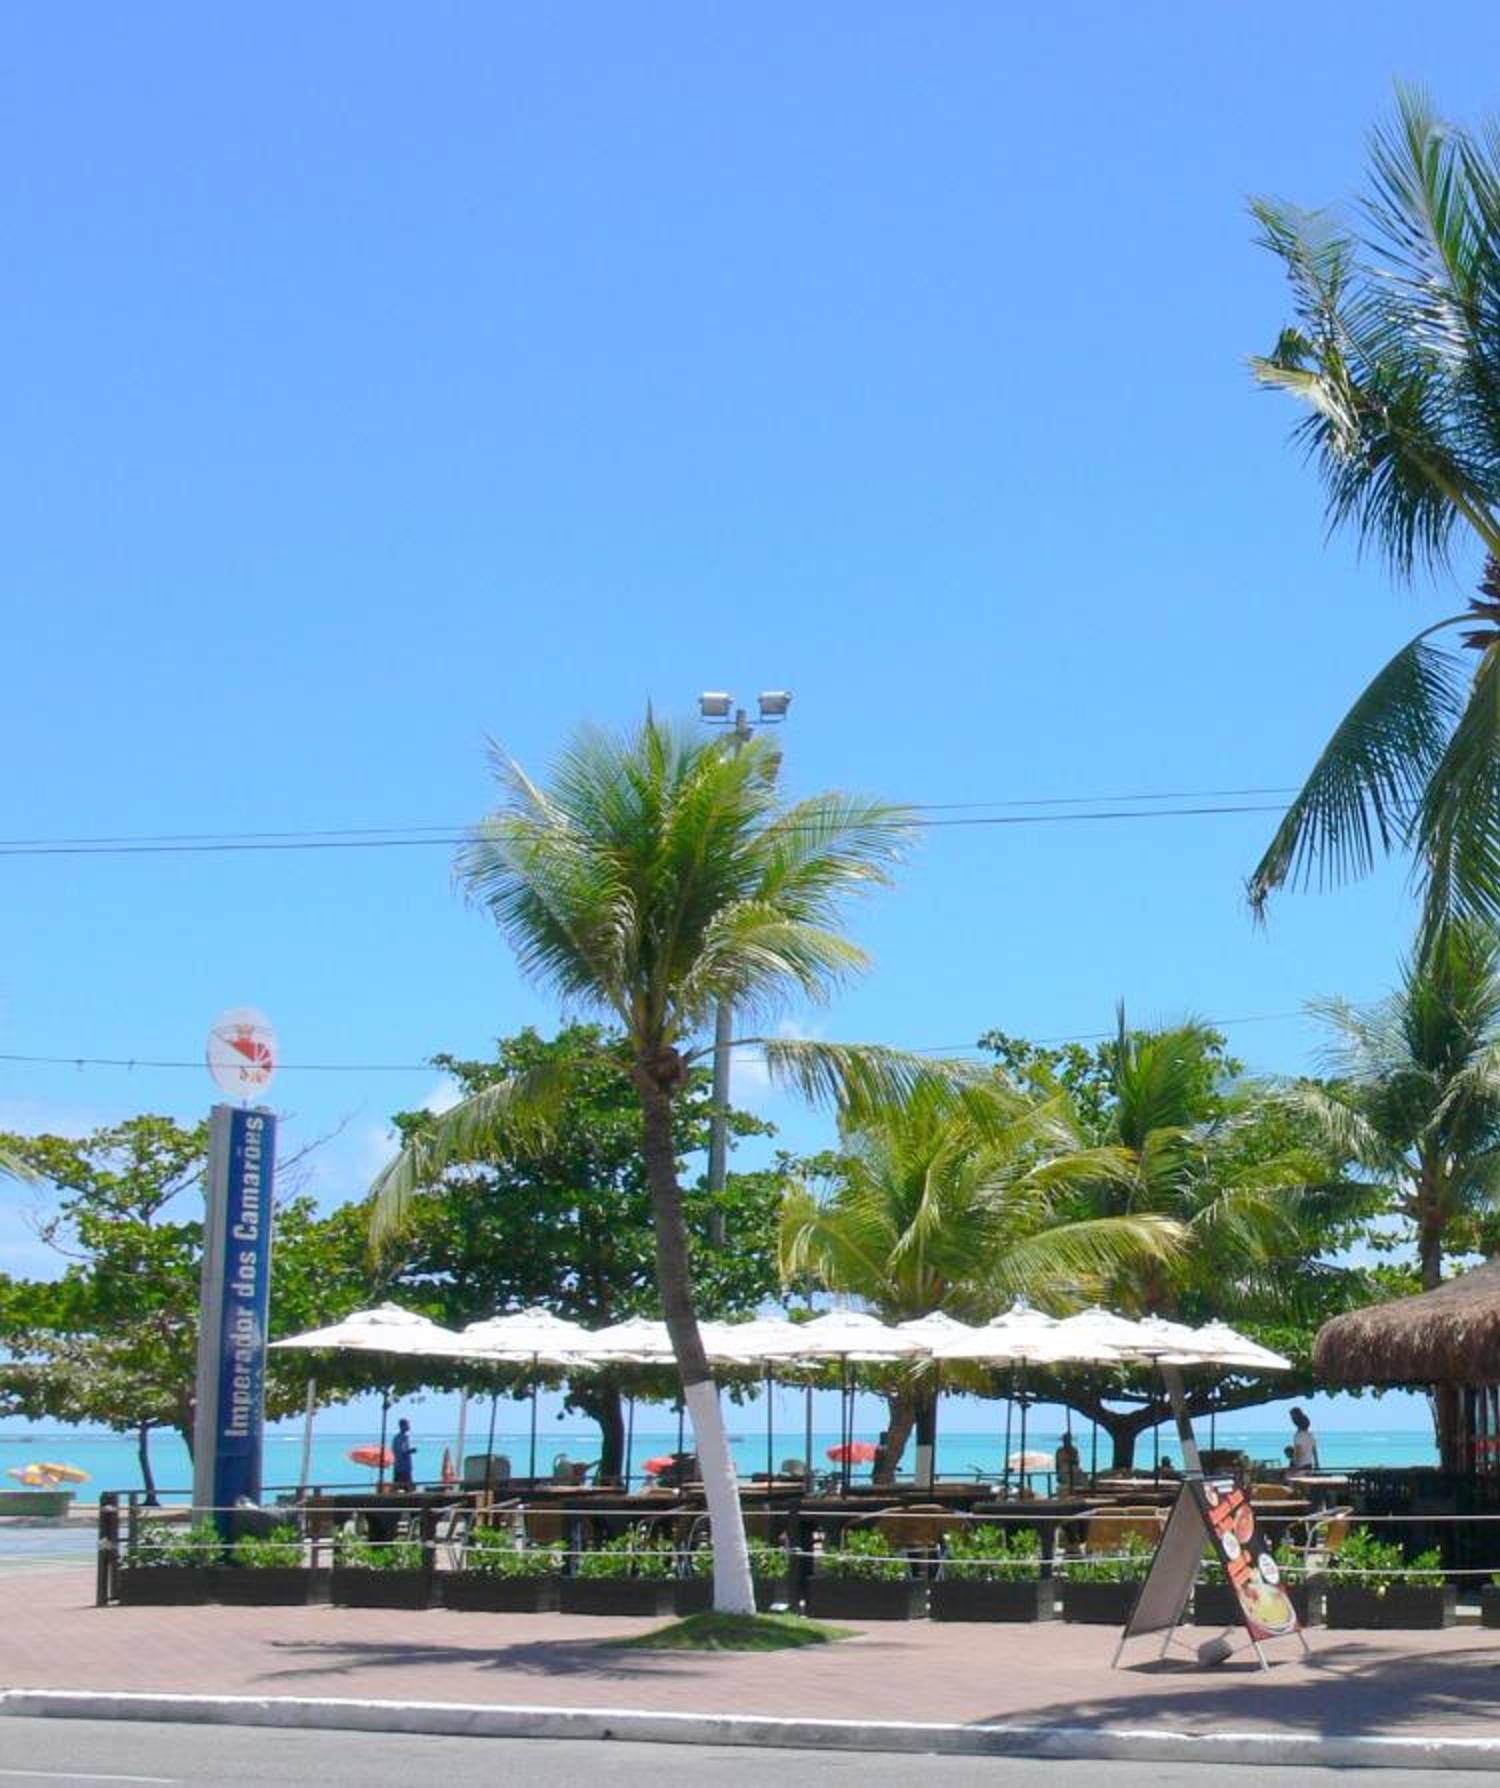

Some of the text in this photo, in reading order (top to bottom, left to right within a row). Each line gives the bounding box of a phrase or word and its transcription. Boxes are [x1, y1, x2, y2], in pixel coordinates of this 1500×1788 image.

[224, 1117, 263, 1437] Imperador dos Camarões
